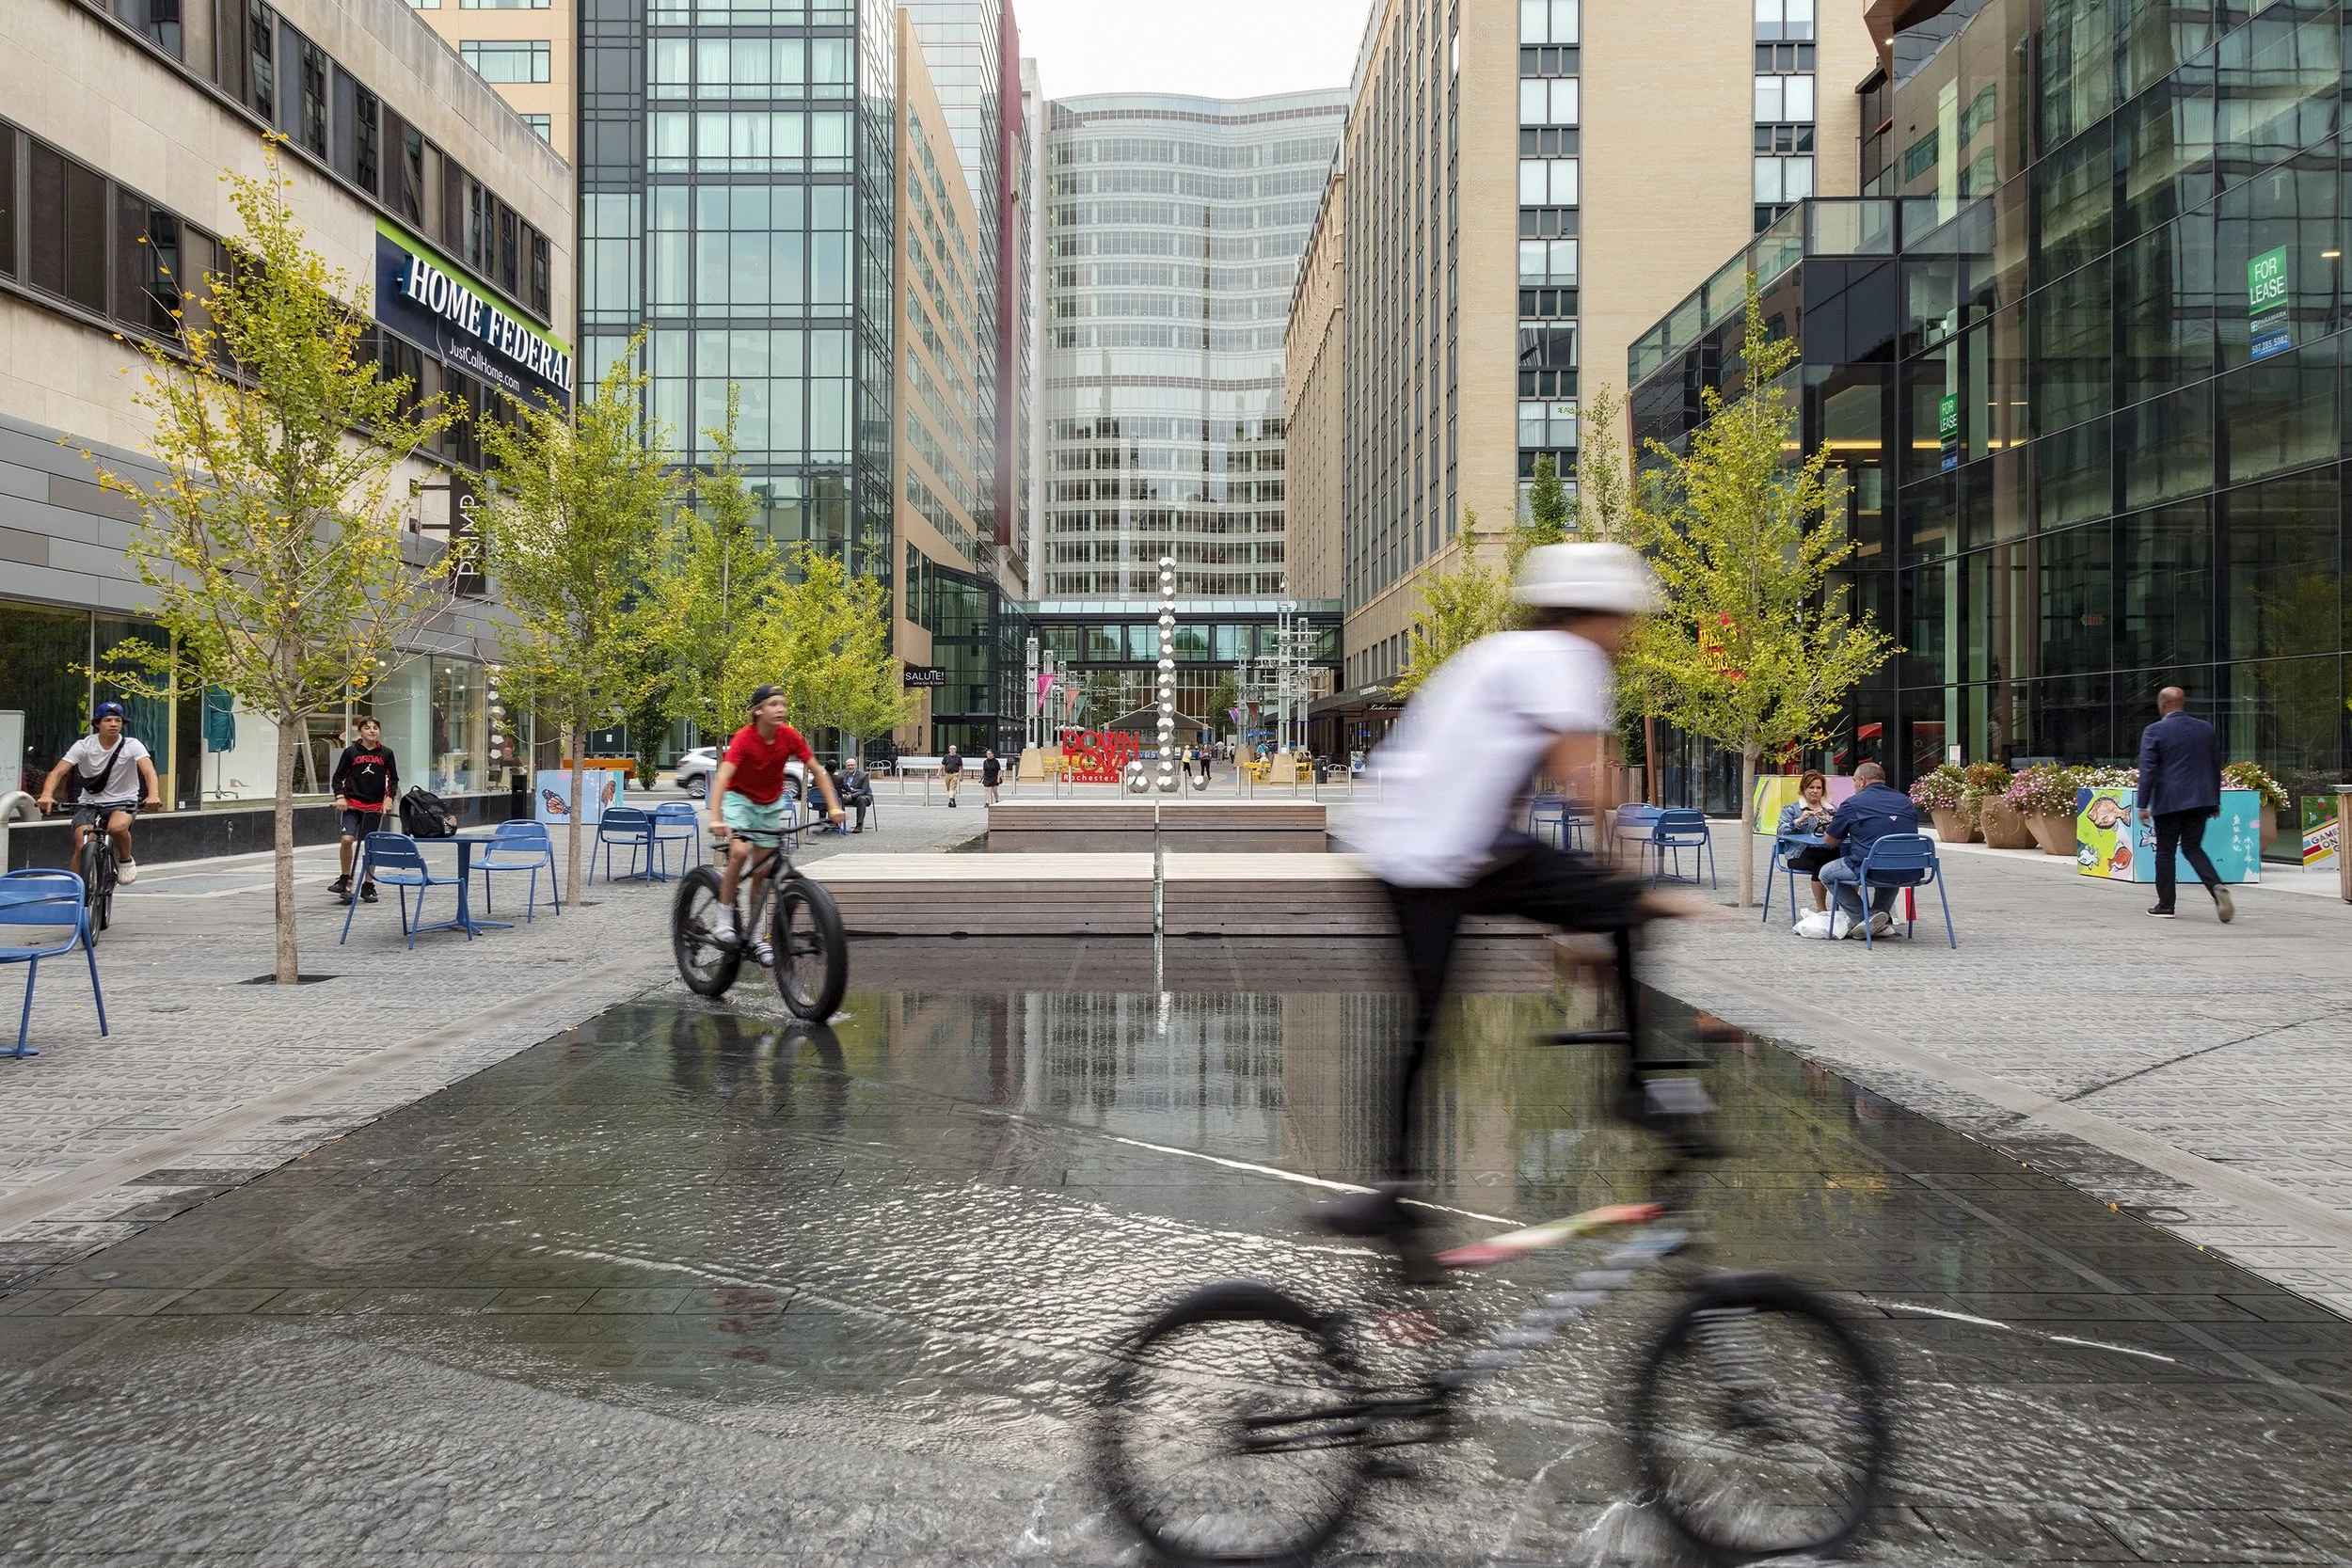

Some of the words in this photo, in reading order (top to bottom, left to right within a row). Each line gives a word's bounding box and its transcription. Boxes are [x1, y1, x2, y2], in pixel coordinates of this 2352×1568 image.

[2254, 257, 2277, 281] FOR
[2249, 276, 2285, 305] LEASE
[406, 253, 484, 338] HOME
[486, 305, 574, 393] FEDERAL
[450, 338, 520, 392] JustCallHome.com
[1942, 400, 1954, 416] FOR
[1940, 413, 1957, 432] LEASE
[905, 670, 945, 681] SALUTE!
[1062, 730, 1139, 753] DOWN
[352, 754, 385, 766] JORDAN
[1063, 773, 1118, 783] Rochester,
[2311, 828, 2340, 845] GAME
[88, 1070, 221, 1082] MOON
[180, 1064, 336, 1074] FATHER
[109, 1082, 288, 1093] DAKOTA
[8, 1091, 198, 1101] MARKED
[2178, 1227, 2317, 1242] AND
